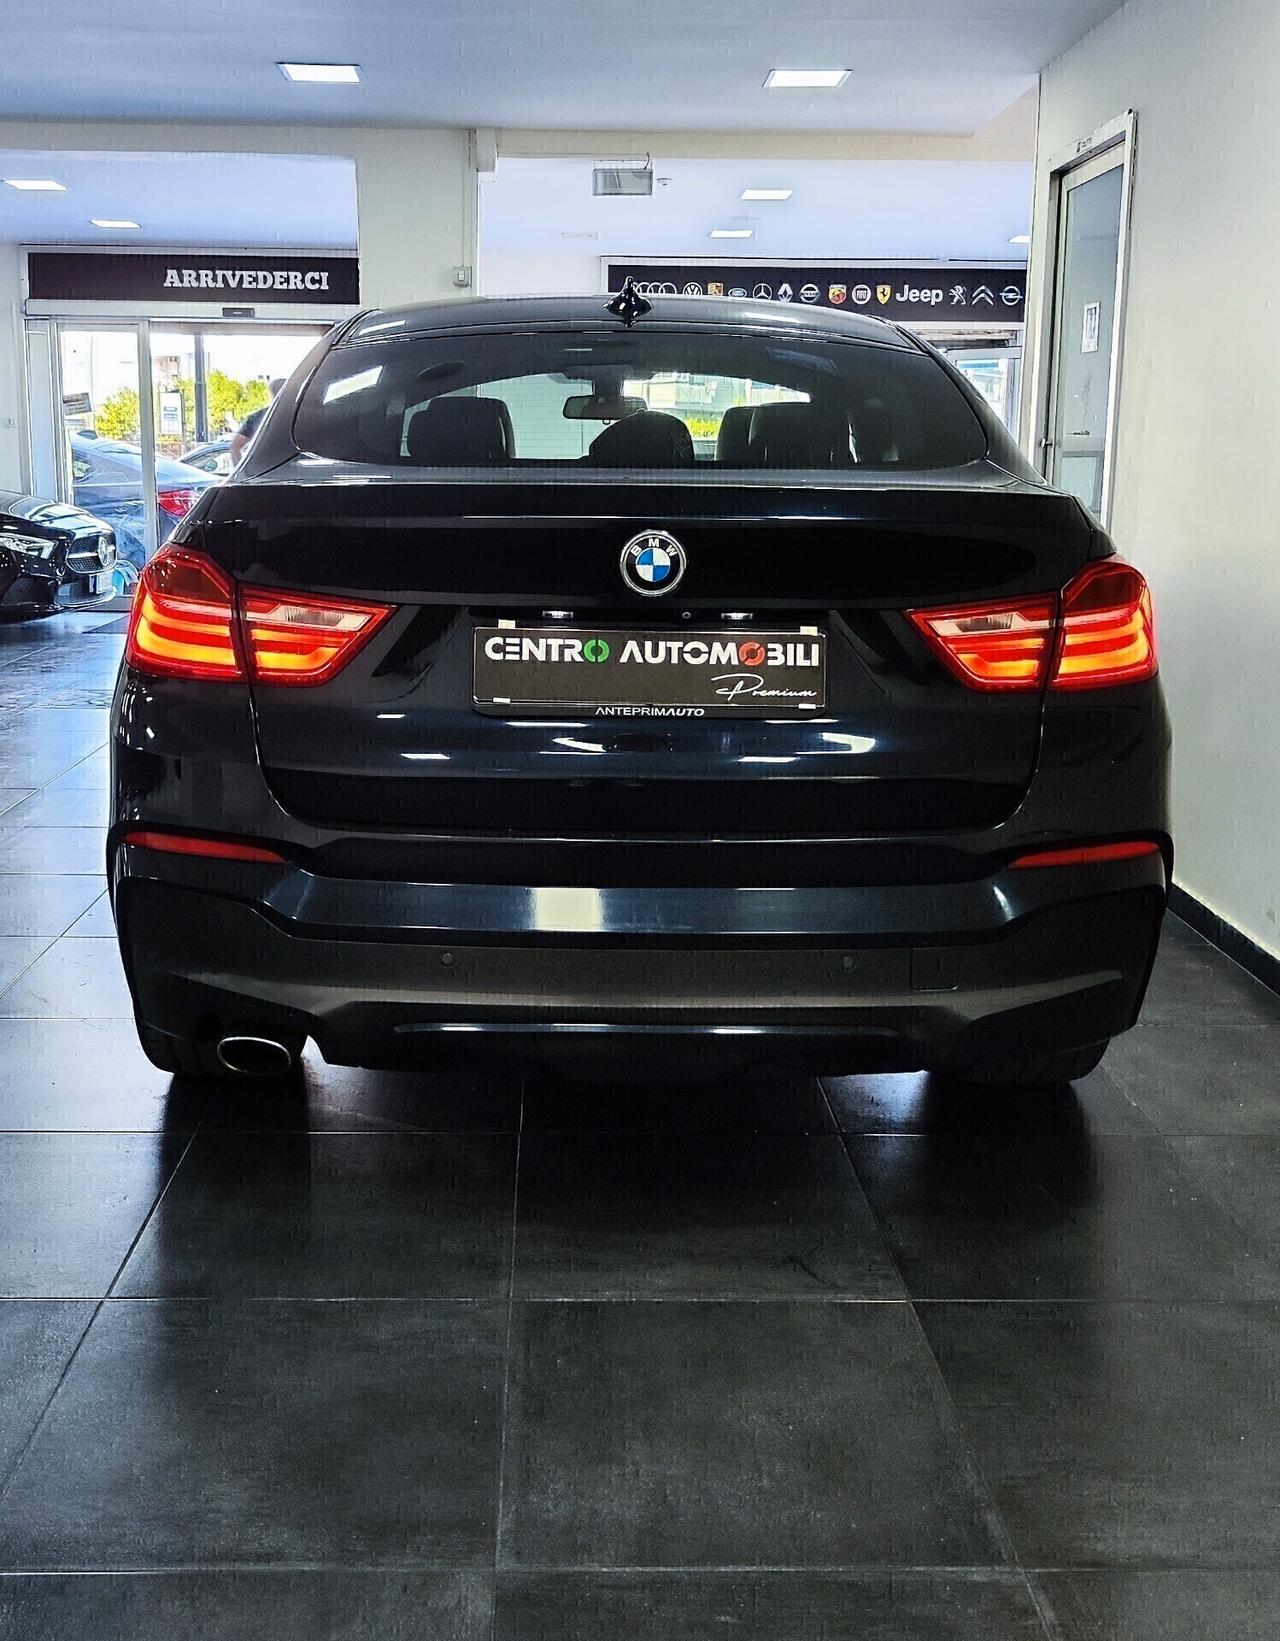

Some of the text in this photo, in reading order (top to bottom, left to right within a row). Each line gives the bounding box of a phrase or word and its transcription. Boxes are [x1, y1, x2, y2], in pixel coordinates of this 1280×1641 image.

[163, 269, 329, 291] ARRIVEDERCI
[896, 284, 944, 305] Jeep
[630, 538, 678, 557] BMW
[484, 636, 820, 667] CENTRO AUTOMOBILI
[711, 672, 818, 701] Premium
[594, 706, 706, 717] ANTEPRIMAUTO
